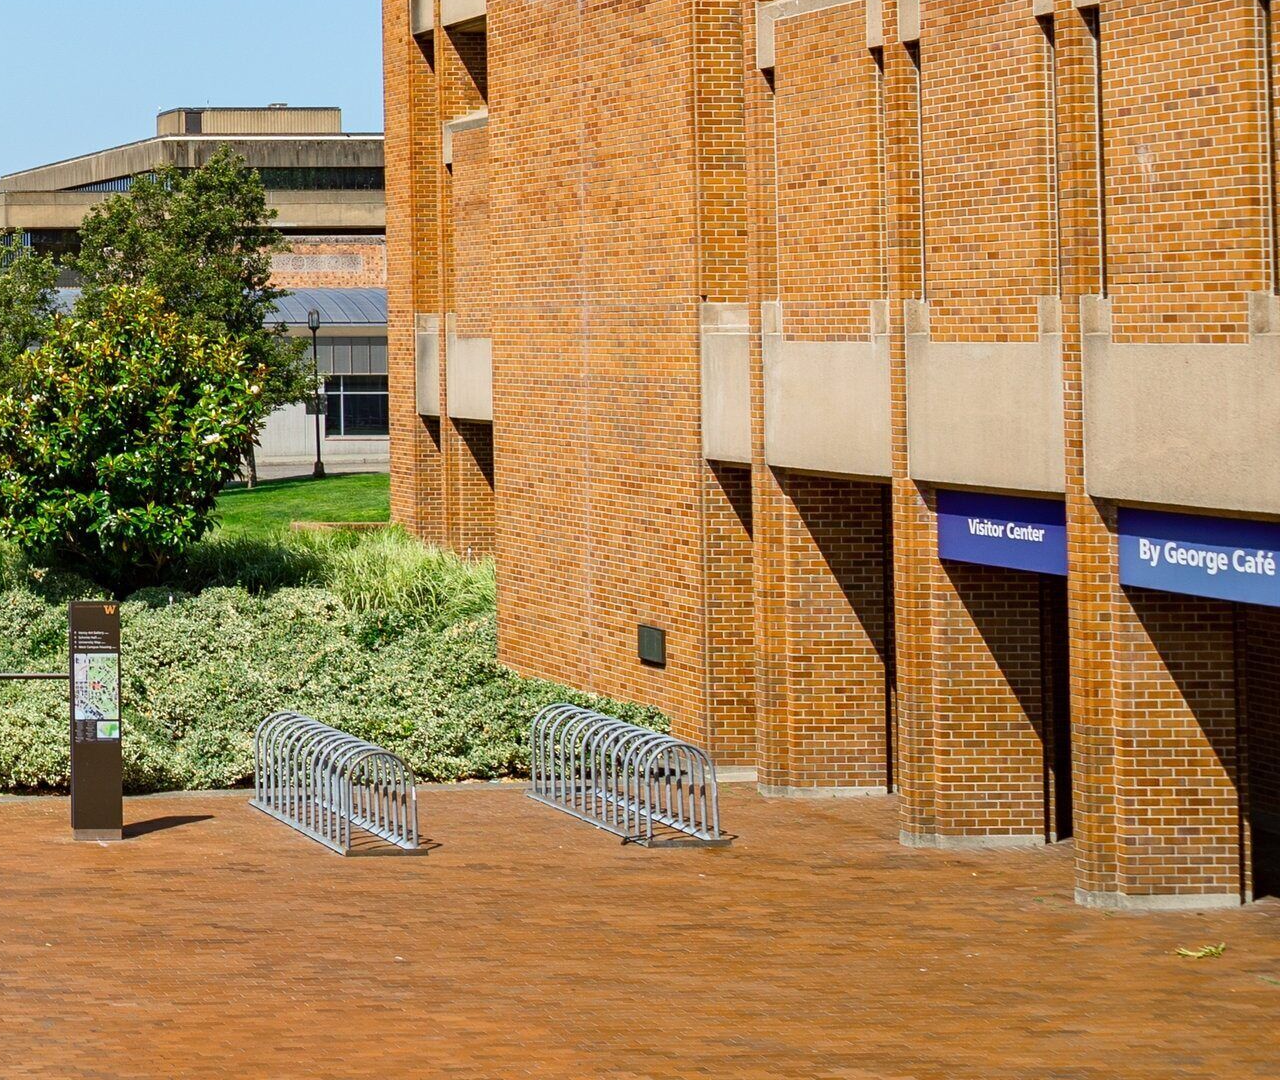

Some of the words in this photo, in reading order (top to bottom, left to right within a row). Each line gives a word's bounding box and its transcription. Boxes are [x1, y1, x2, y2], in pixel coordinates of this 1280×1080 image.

[968, 518, 1004, 538] Visitor
[1006, 522, 1045, 542] Center
[1139, 538, 1160, 567] By
[1164, 541, 1228, 575] George
[1232, 549, 1276, 576] Café
[103, 605, 116, 615] W
